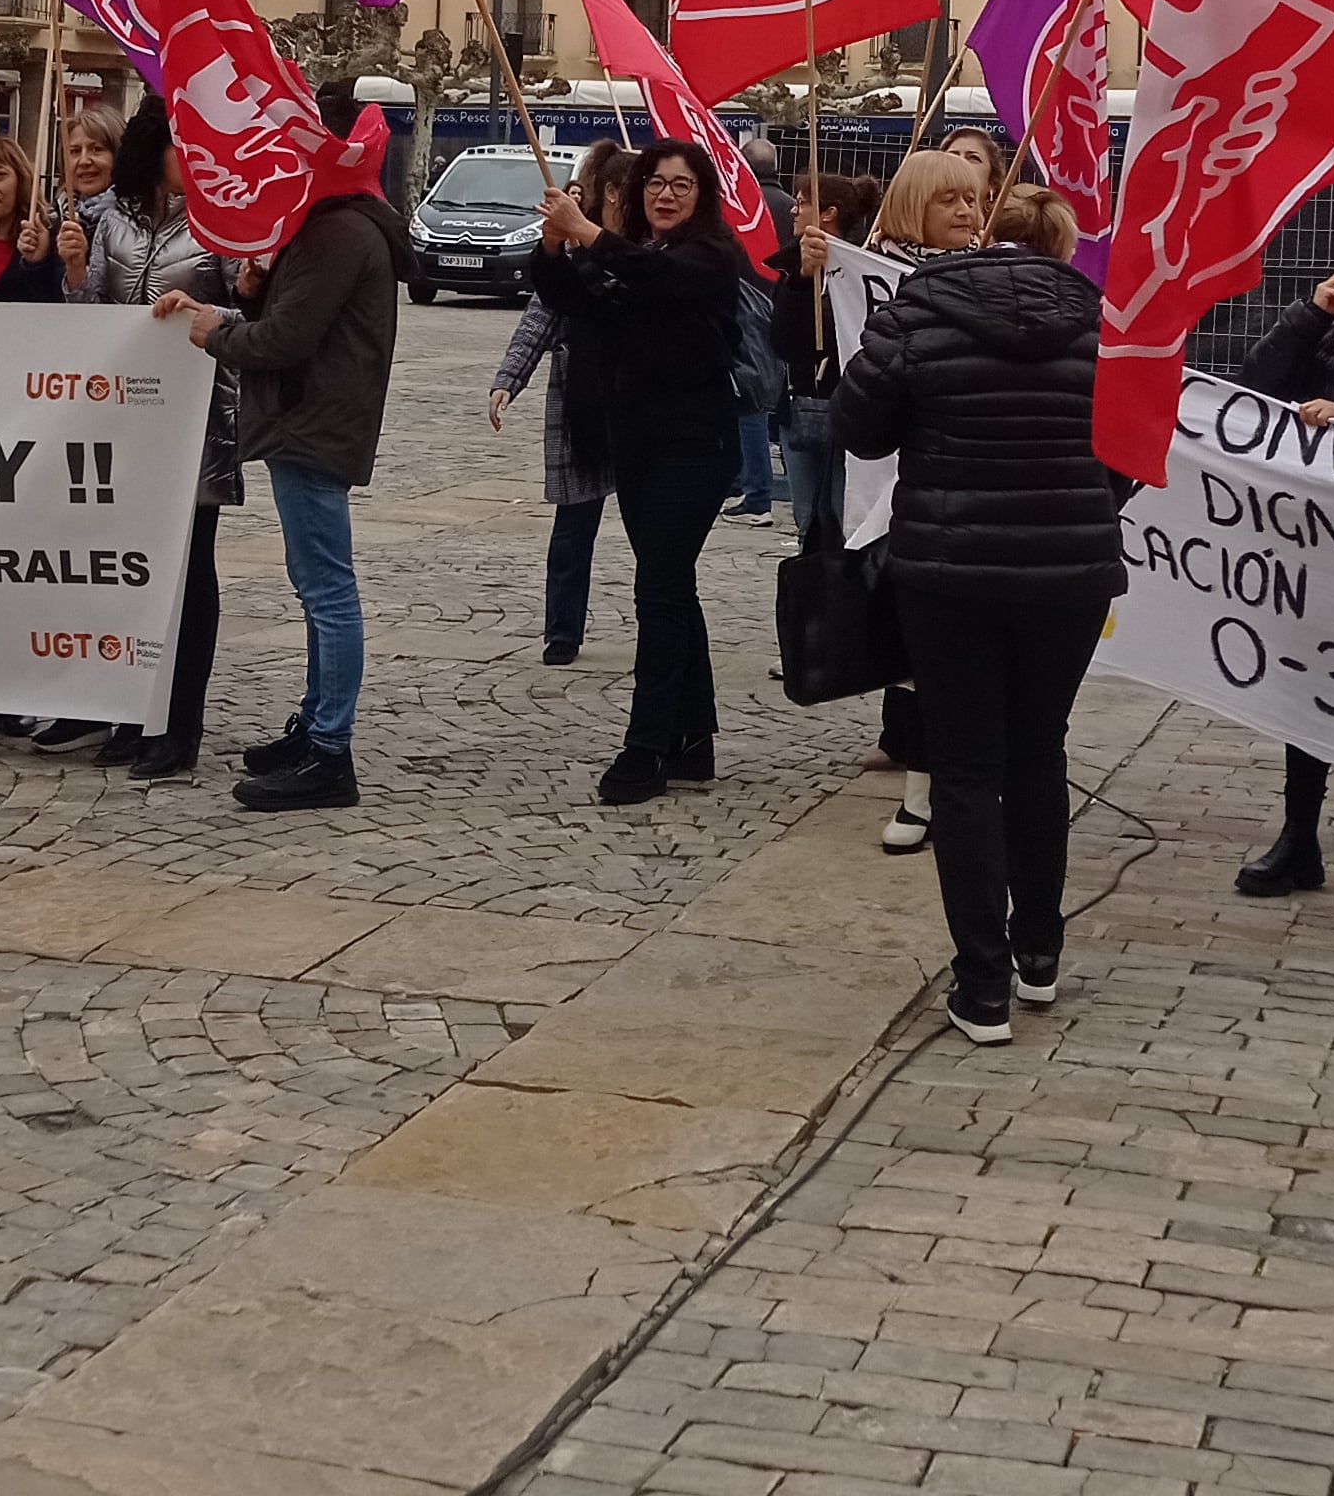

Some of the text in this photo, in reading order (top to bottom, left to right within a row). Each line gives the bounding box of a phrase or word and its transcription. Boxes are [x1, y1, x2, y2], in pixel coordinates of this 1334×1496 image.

[514, 115, 522, 126] y
[568, 115, 576, 124] a
[579, 112, 589, 124] la
[26, 372, 82, 400] UGT
[125, 377, 161, 385] Servicios
[126, 386, 159, 395] Públicos
[127, 396, 165, 406] Palencia
[1119, 514, 1307, 619] CACIÓN
[30, 631, 93, 659] UGT
